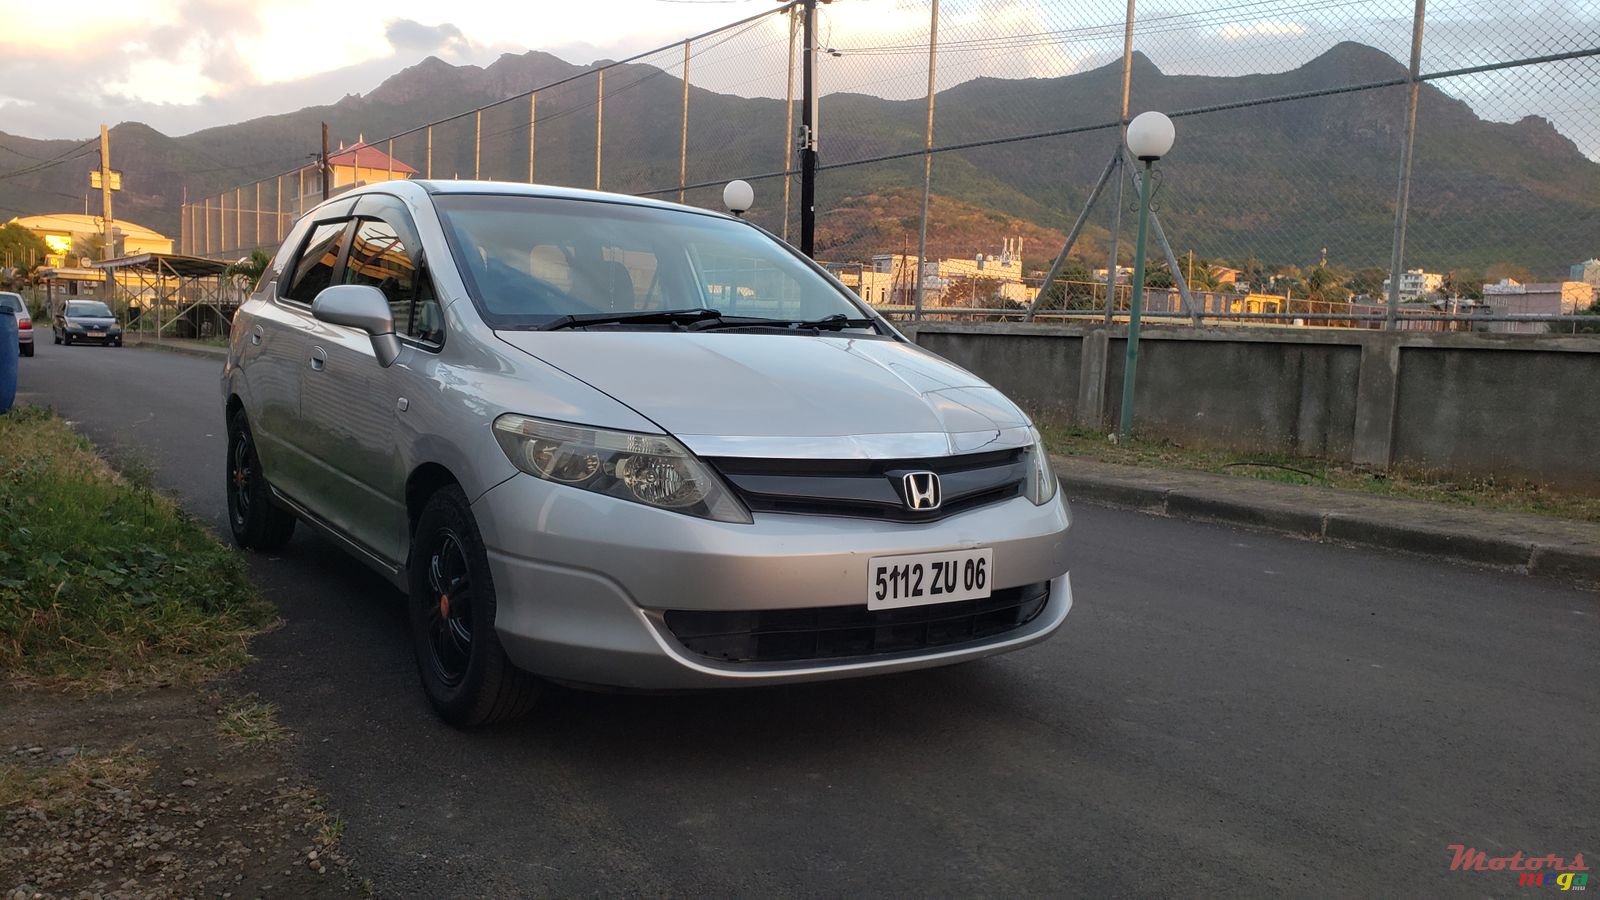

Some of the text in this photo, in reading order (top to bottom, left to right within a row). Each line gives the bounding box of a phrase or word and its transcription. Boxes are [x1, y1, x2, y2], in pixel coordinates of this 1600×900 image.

[875, 557, 986, 601] 5112 ZU 06
